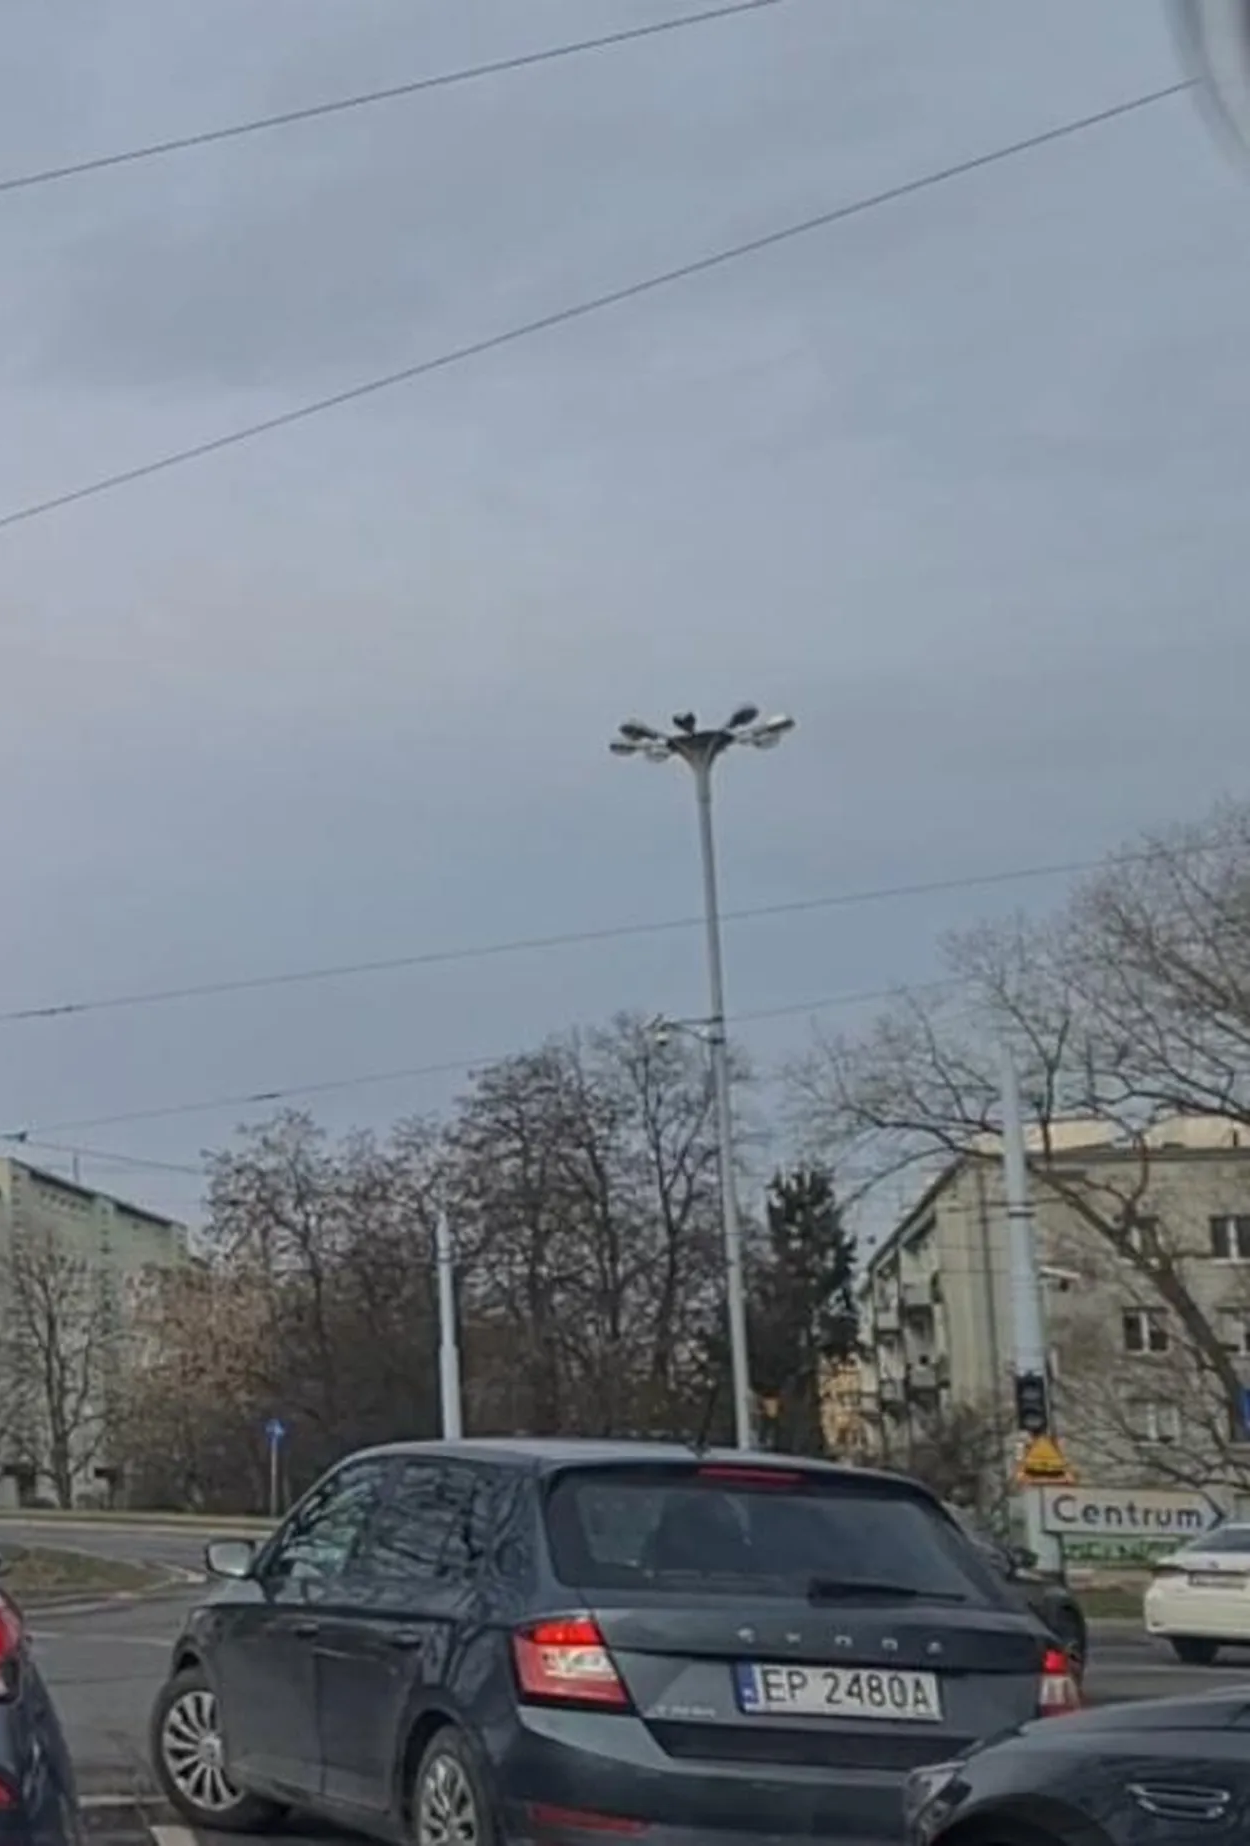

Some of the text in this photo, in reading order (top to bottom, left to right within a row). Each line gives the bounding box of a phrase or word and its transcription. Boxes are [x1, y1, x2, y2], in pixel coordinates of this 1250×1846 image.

[1053, 1494, 1201, 1528] Centrum
[761, 1669, 932, 1710] EP 2480A
